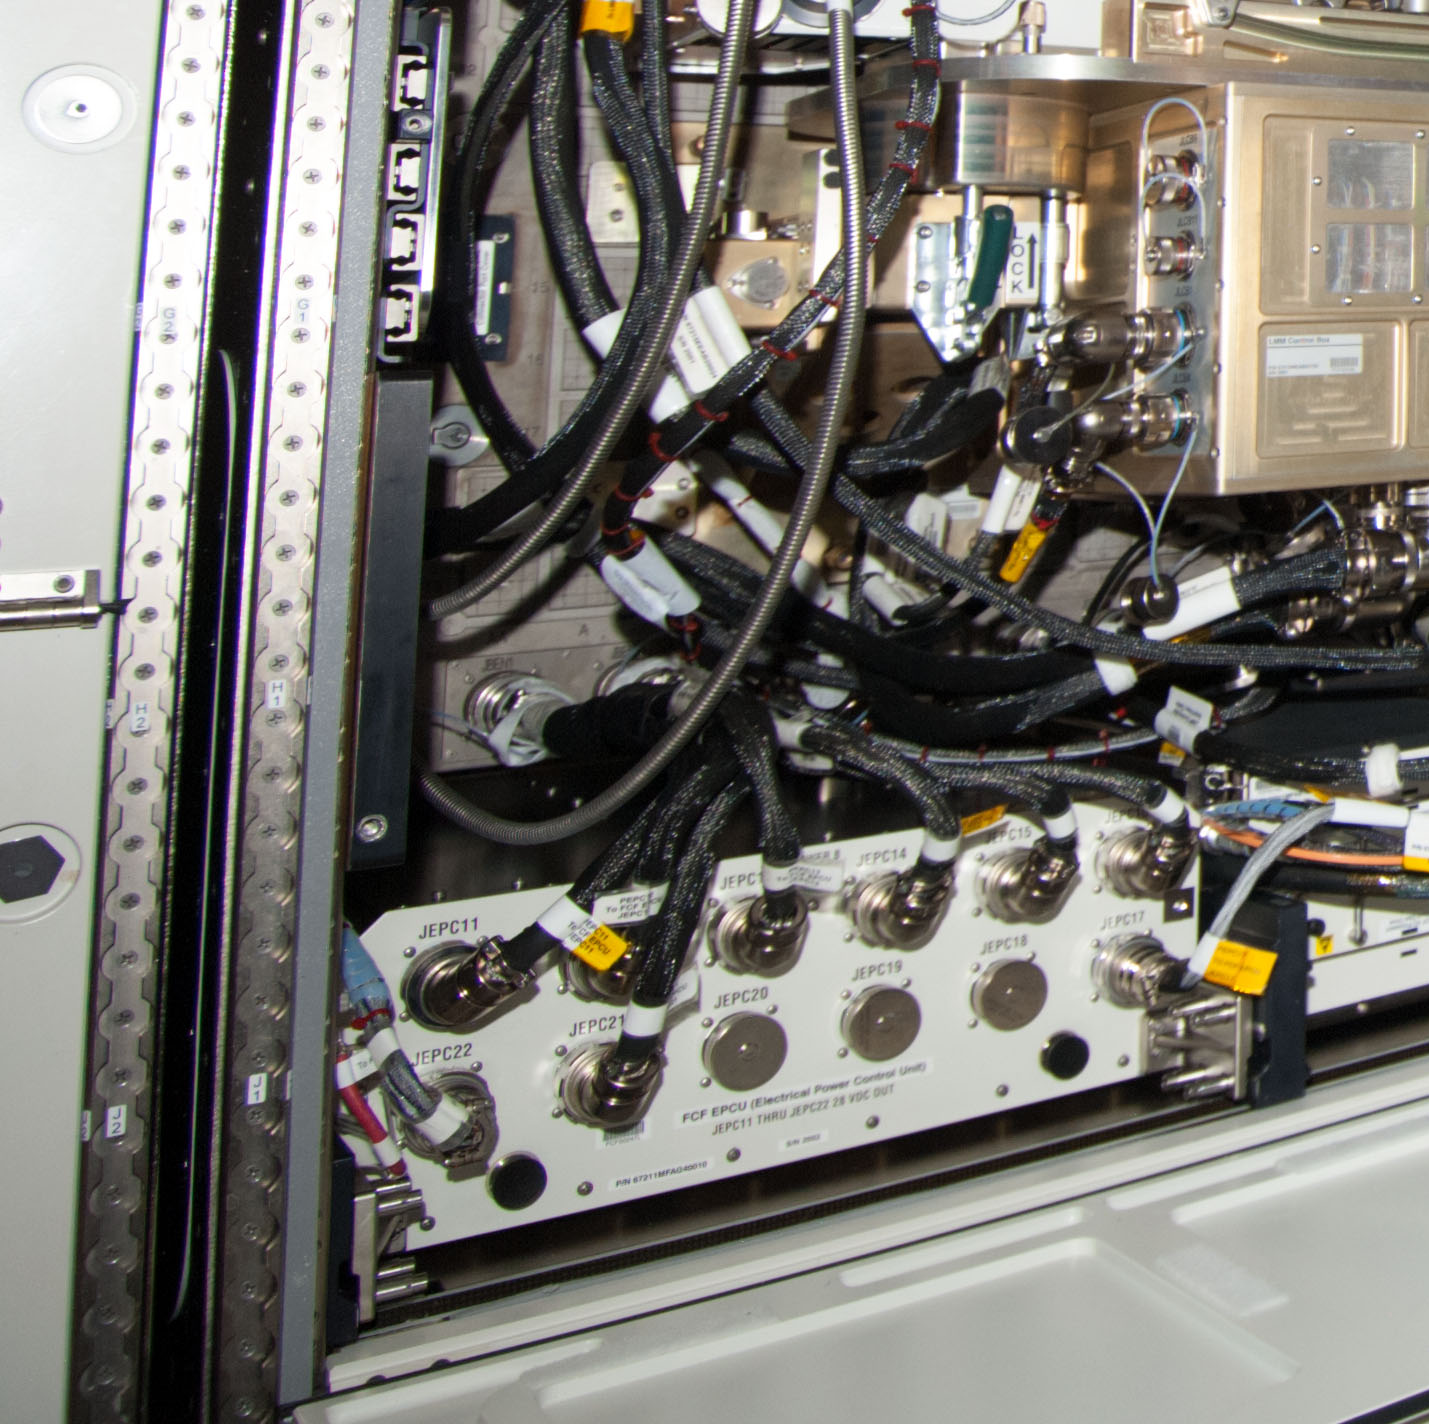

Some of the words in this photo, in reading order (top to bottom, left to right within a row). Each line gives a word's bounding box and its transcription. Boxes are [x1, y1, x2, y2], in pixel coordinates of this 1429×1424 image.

[857, 847, 908, 868] JEPC14
[720, 873, 763, 891] JEPC
[419, 917, 478, 940] JEPC11
[1100, 910, 1146, 930] JEPC17
[980, 934, 1028, 955] JEPC18
[851, 960, 903, 981] JEPC19
[714, 986, 769, 1009] JEPC20
[569, 1013, 625, 1038] JEPC21
[413, 1041, 473, 1068] JEPC22
[682, 1108, 708, 1124] FCF
[711, 1100, 748, 1118] EPCU
[750, 1086, 812, 1110] (Electrical
[814, 1078, 850, 1096] Power
[853, 1069, 896, 1086] Control
[899, 1061, 926, 1077] Unit)
[712, 1117, 753, 1136] JEPC11
[757, 1108, 788, 1127] THRU
[789, 1100, 829, 1118] JEPC22
[832, 1096, 846, 1108] 28
[849, 1089, 871, 1103] VDC
[873, 1083, 895, 1097] OUT
